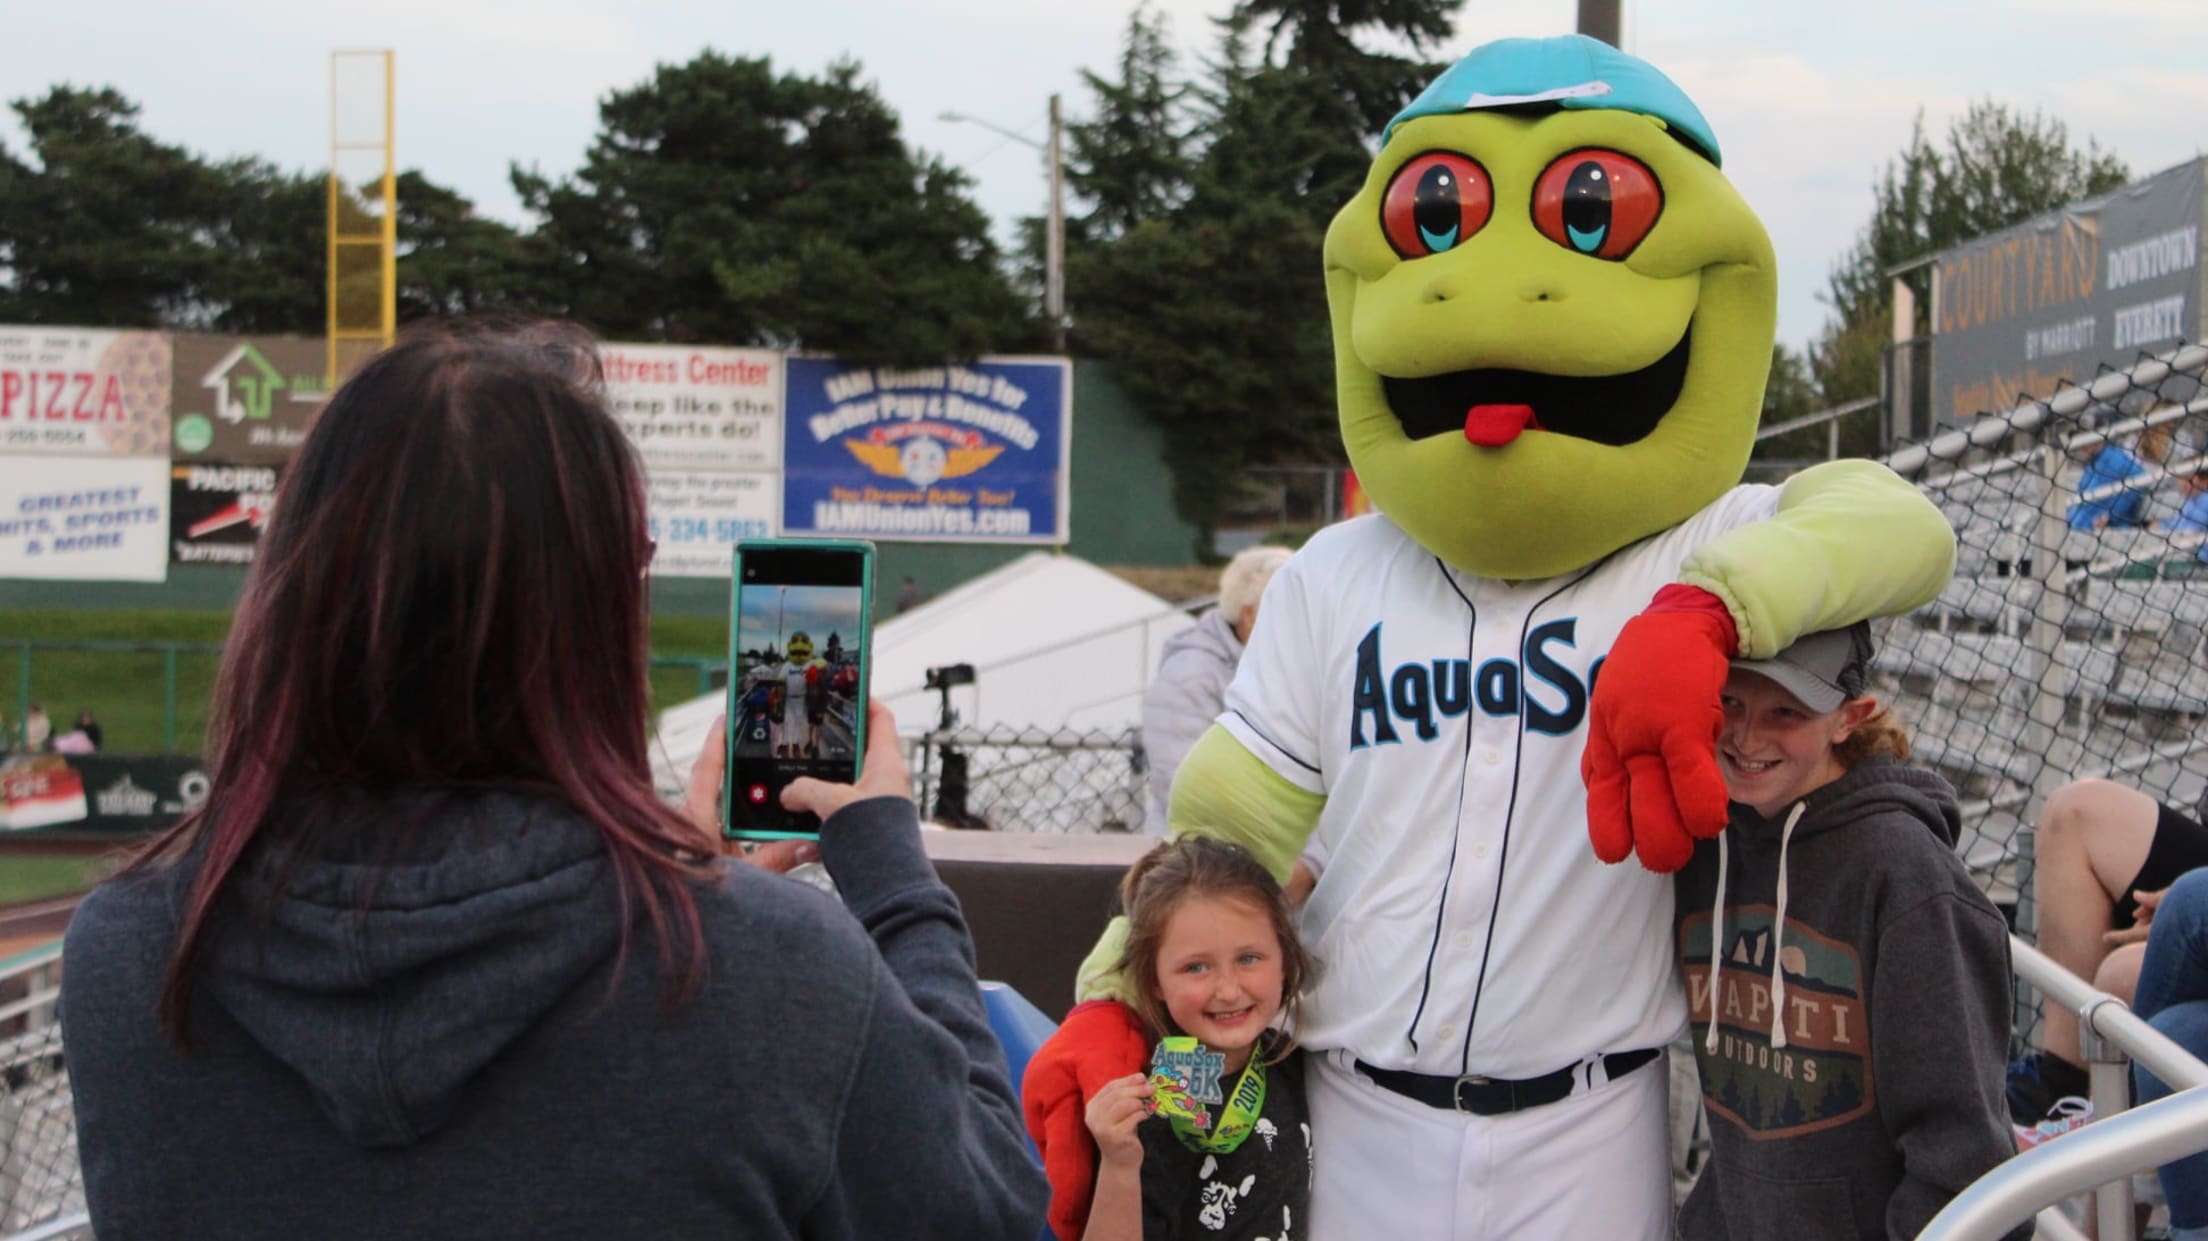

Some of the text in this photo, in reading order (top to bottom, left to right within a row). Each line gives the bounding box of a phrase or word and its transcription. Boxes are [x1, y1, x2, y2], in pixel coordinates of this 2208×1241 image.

[2107, 226, 2197, 290] DOWNTOWN
[2114, 295, 2184, 350] EVERETT
[688, 354, 770, 385] Center
[1, 371, 125, 421] PIZZA
[824, 370, 875, 404] IAM
[947, 367, 992, 398] Yes
[990, 375, 1029, 411] for
[674, 396, 721, 415] like
[733, 399, 774, 417] the
[809, 400, 880, 443] Better
[880, 393, 927, 422] Pay
[945, 393, 1040, 450] Benefits
[626, 421, 761, 440] xperts do!
[187, 467, 275, 492] PACIFIC
[19, 488, 141, 513] GREATEST
[66, 506, 159, 531] SPORTS
[813, 500, 1031, 534] IAMUnionYes.com
[54, 531, 123, 551] MORE
[1689, 973, 1850, 1043] WAPTI
[1153, 1043, 1225, 1069] AquaSox
[1233, 1074, 1262, 1114] 2019
